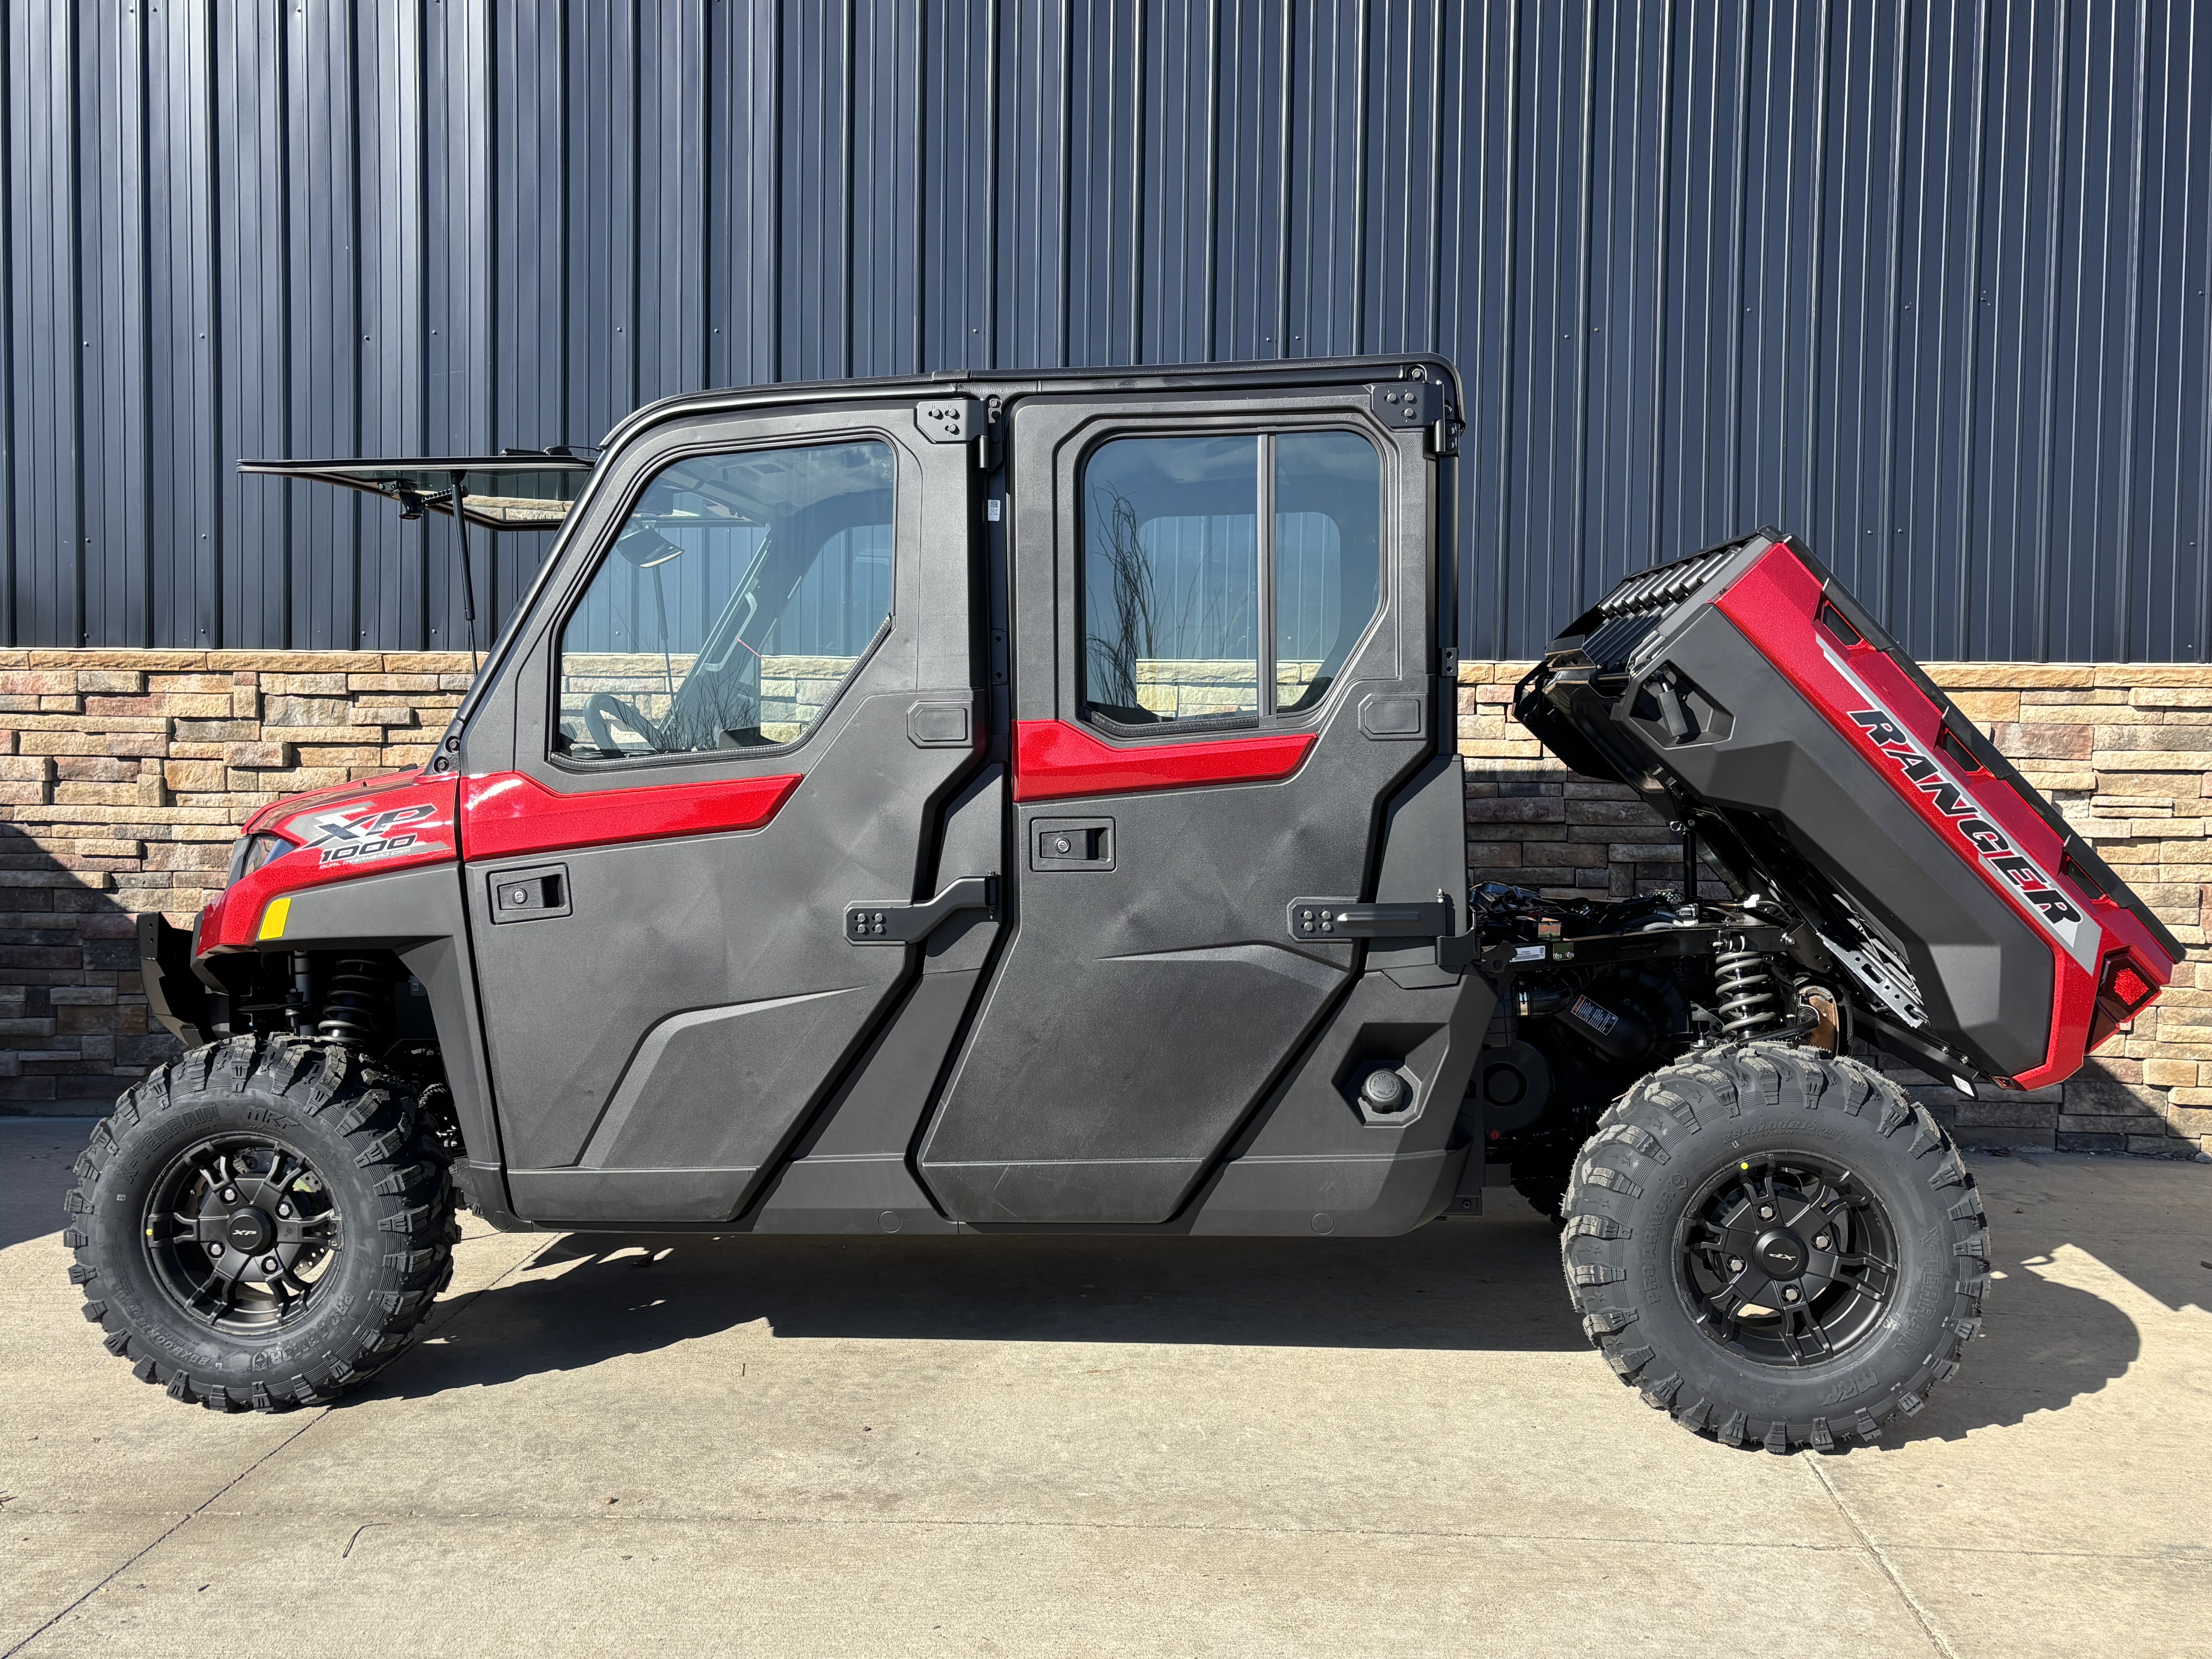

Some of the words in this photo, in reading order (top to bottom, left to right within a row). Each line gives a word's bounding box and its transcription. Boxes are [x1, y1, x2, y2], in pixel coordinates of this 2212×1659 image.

[297, 804, 437, 850] XP
[1847, 709, 2083, 925] RANGER
[319, 834, 417, 864] 1000
[343, 852, 390, 865] OVERHEAD
[115, 1104, 220, 1184] X-TERRAIN
[1642, 1188, 1676, 1259] ARMOR
[1642, 1262, 1661, 1305] PRO
[1892, 1226, 1944, 1358] X-TERRAIN
[328, 1290, 355, 1326] PRO
